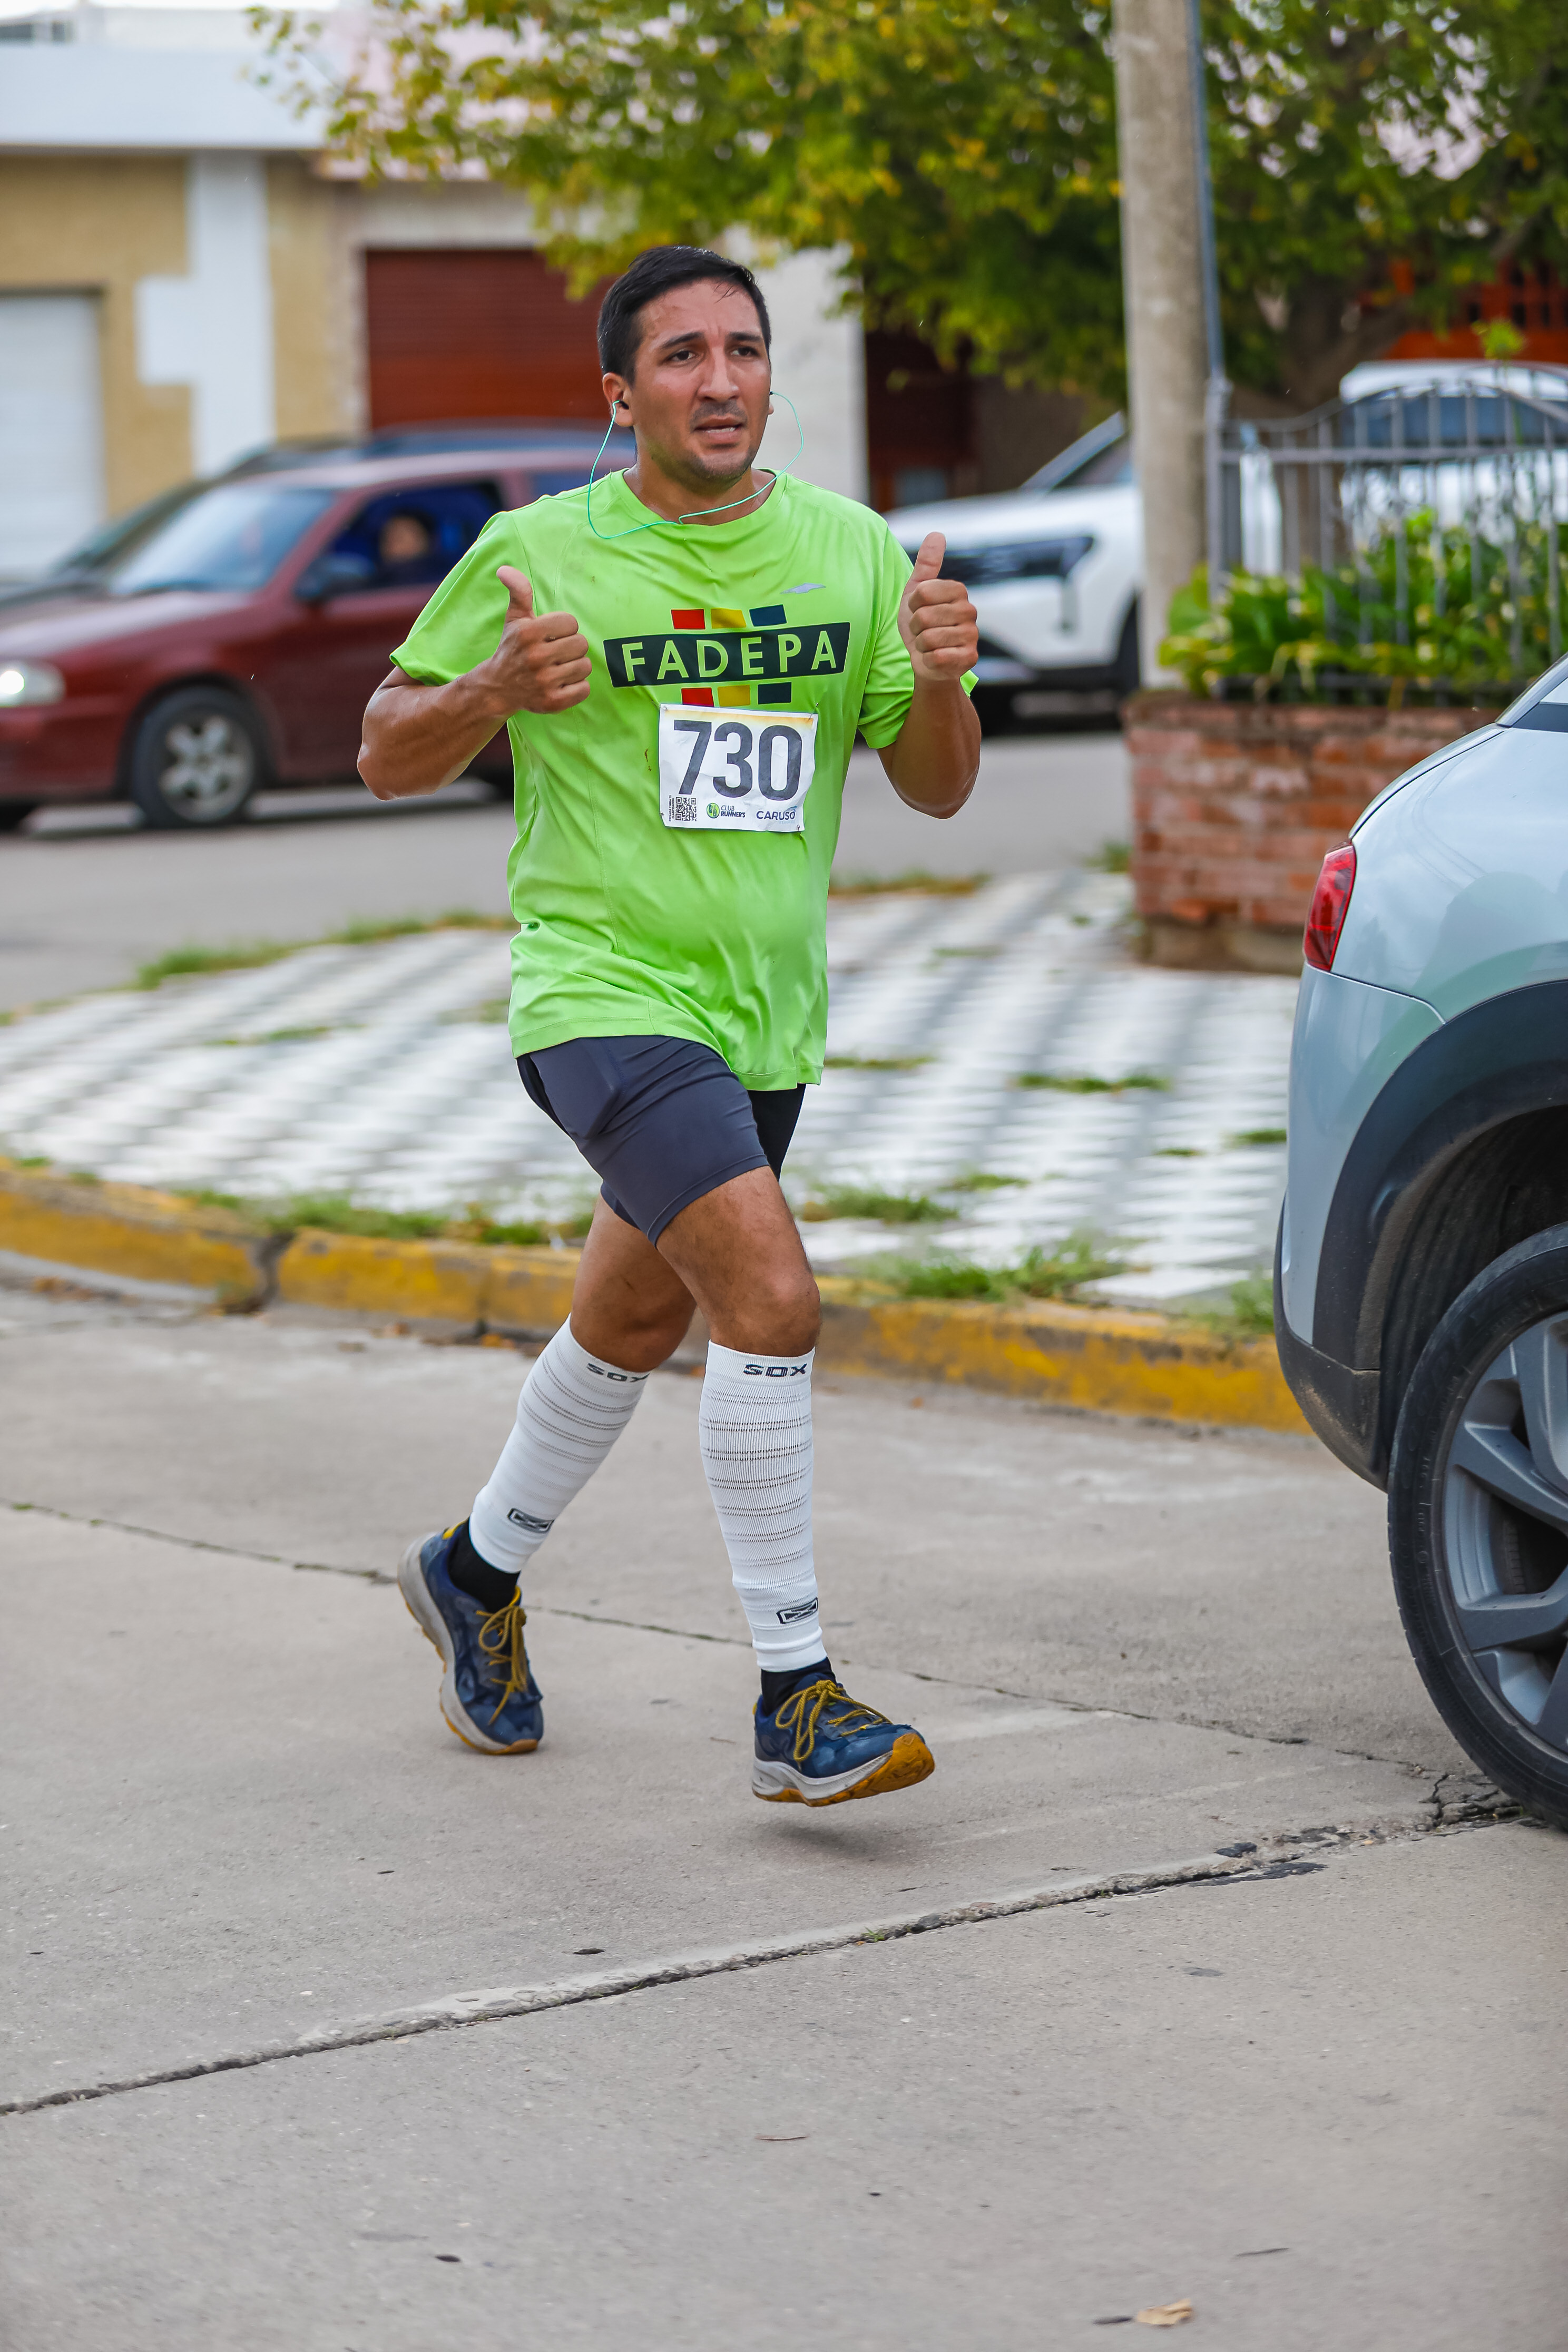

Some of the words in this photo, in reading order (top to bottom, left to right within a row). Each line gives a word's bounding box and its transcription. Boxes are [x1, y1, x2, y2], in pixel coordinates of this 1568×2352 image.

[622, 631, 837, 682] FADEPA
[674, 719, 802, 801] 730
[756, 810, 796, 820] CARUSO
[586, 1363, 651, 1383] SOX
[743, 1363, 808, 1377] SOX
